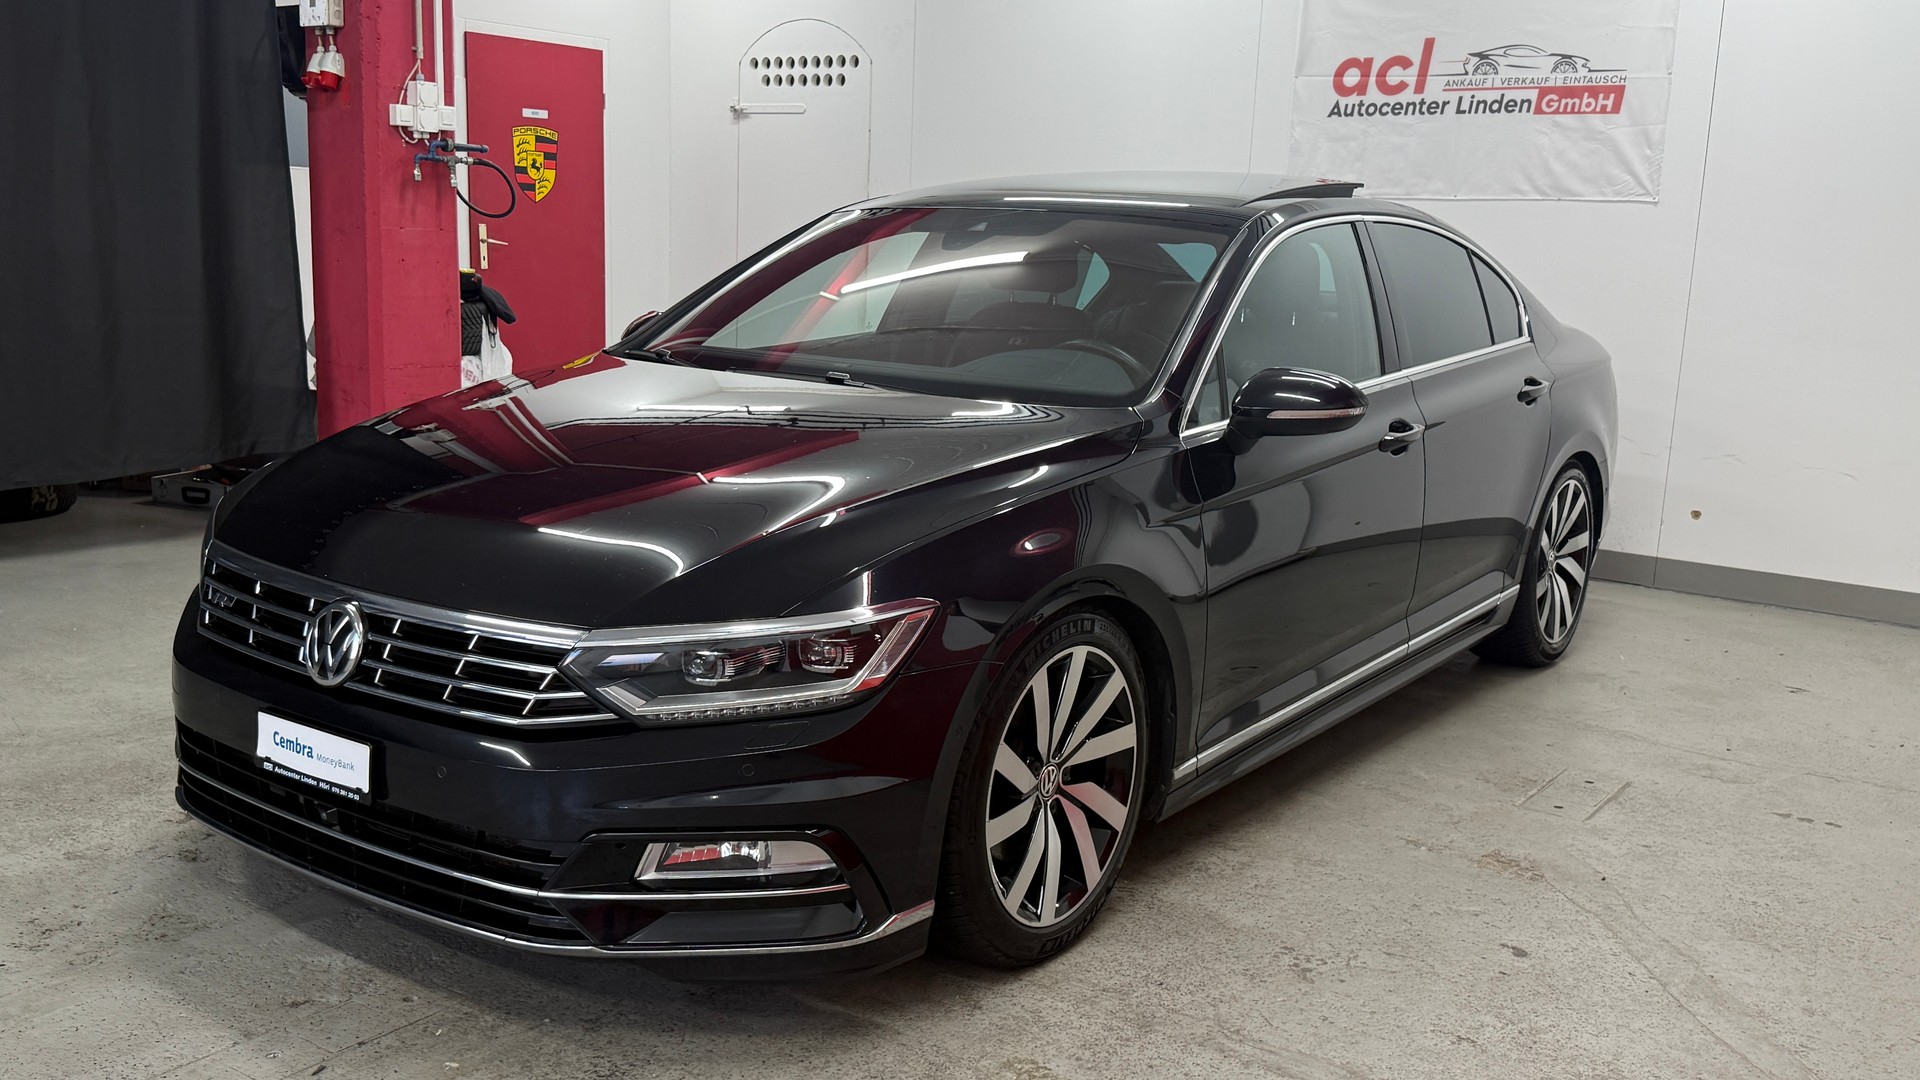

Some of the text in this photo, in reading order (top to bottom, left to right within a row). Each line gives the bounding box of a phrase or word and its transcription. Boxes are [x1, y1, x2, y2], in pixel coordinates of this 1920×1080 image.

[1332, 37, 1436, 97] acl
[1444, 74, 1627, 88] ANKAUF VERKAUF EINTAUSCH
[1327, 93, 1615, 118] Autocenter Linden GmbH
[513, 127, 557, 139] PORSCHE
[1024, 618, 1092, 668] MICHELIN
[273, 731, 355, 772] Cembra MoneyBank
[274, 766, 301, 780] Autocenter
[301, 774, 317, 786] Linden
